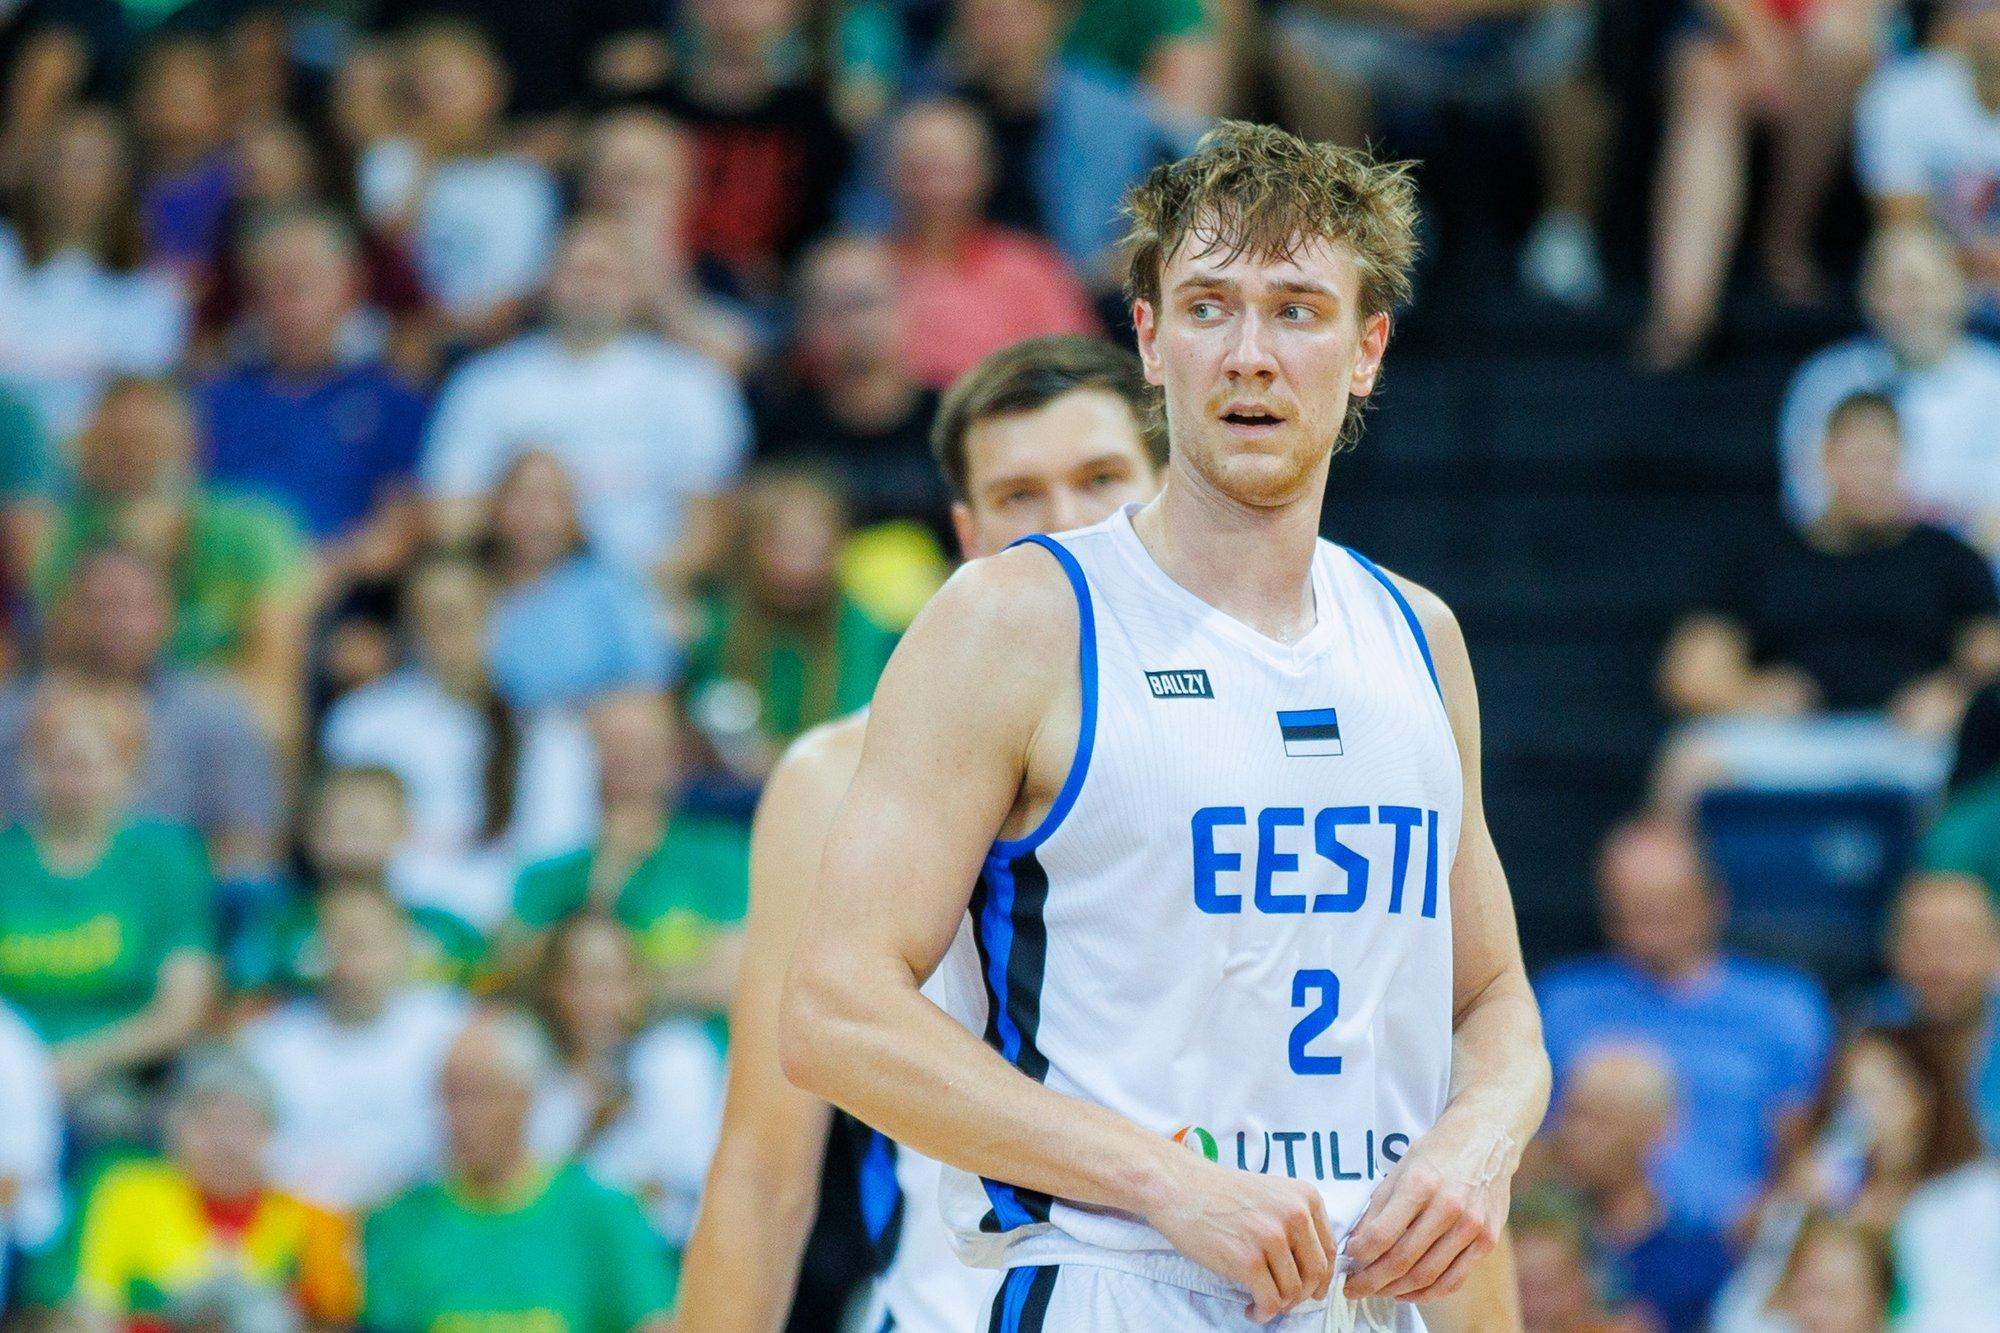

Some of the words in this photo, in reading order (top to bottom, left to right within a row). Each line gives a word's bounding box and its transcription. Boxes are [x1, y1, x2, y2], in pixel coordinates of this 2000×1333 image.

[1147, 673, 1207, 695] BALLZY
[1191, 805, 1438, 918] EESTI
[1288, 969, 1342, 1075] 2
